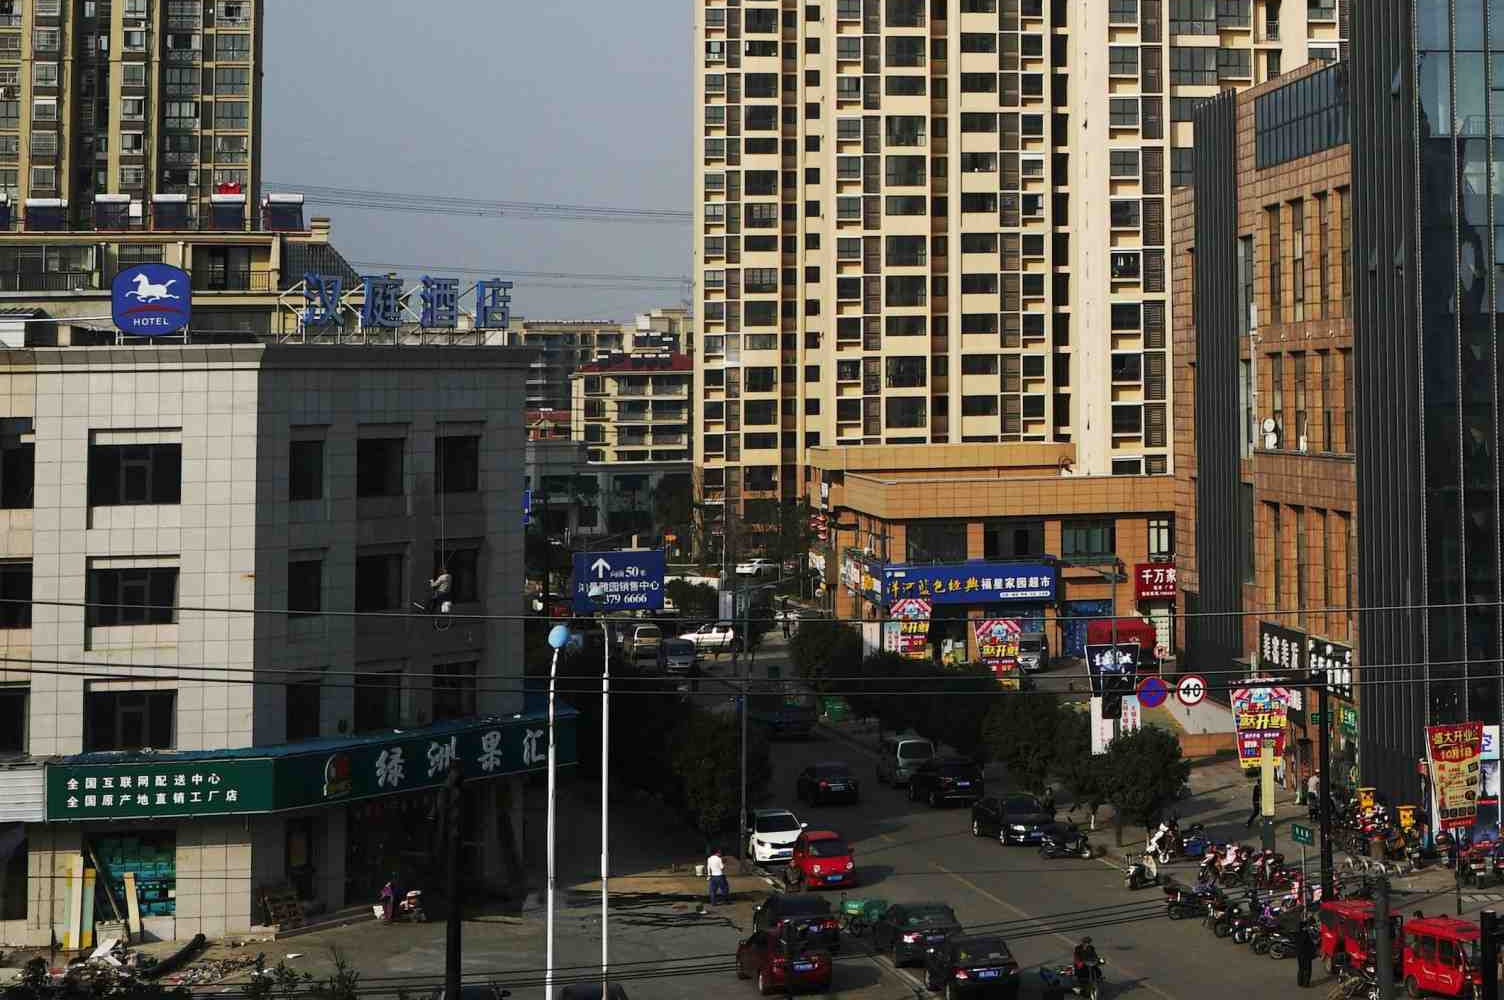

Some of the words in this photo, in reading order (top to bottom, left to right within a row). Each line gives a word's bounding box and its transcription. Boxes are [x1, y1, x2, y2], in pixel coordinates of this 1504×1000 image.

[304, 272, 513, 328] 汉庭酒店
[133, 318, 169, 327] HOTEL
[1182, 683, 1201, 698] 40
[67, 773, 221, 790] 全国互联网配送中心
[67, 790, 240, 809] 全国原产地直销工厂店
